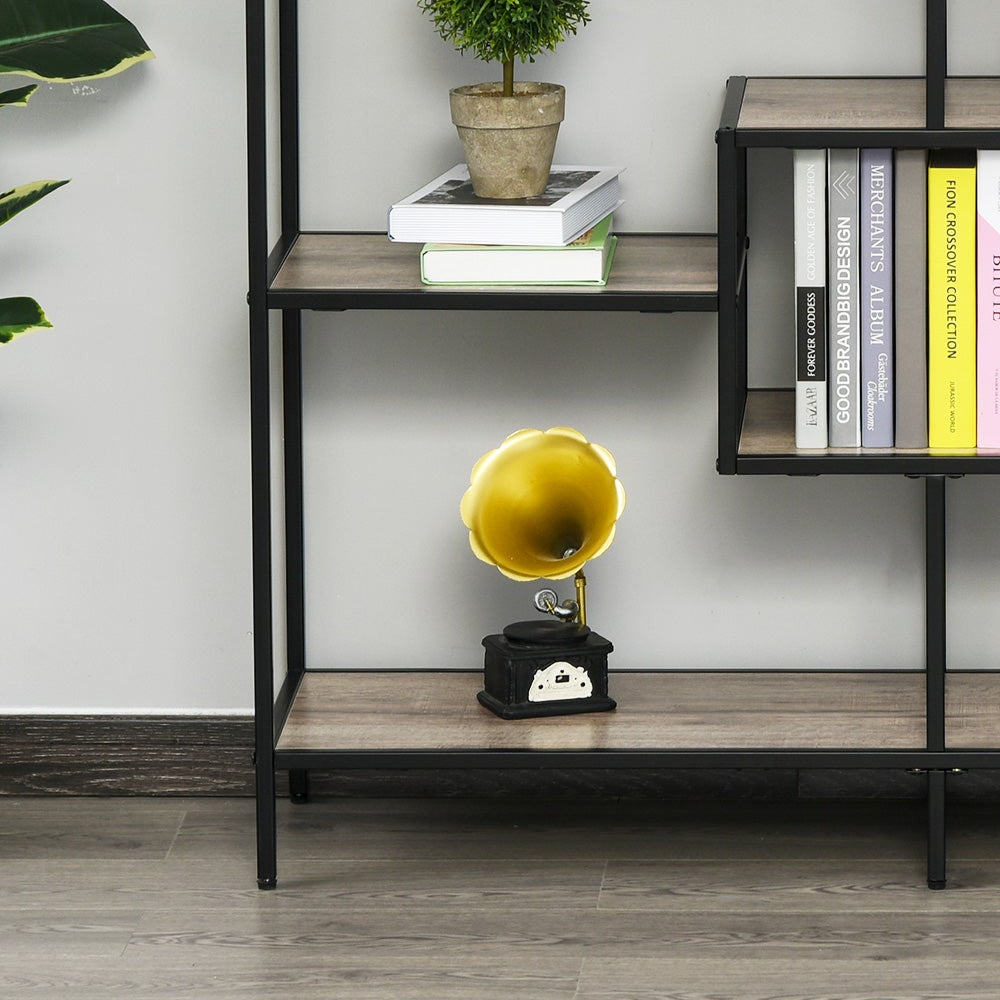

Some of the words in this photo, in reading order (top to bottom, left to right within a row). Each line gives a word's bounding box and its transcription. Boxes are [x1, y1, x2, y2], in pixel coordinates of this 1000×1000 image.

[805, 163, 816, 203] FASHION
[946, 179, 957, 209] FION
[805, 206, 816, 219] OF
[805, 221, 816, 240] AGE
[870, 164, 884, 273] MERCHANTS
[805, 243, 816, 281] GOLDEN
[946, 210, 957, 284] CROSSOVER
[806, 292, 817, 336] GODDESS
[870, 285, 884, 345] ALBUM
[946, 286, 957, 359] COLLECTION
[806, 337, 817, 377] FOREVER
[866, 380, 876, 431] Cloakrooms
